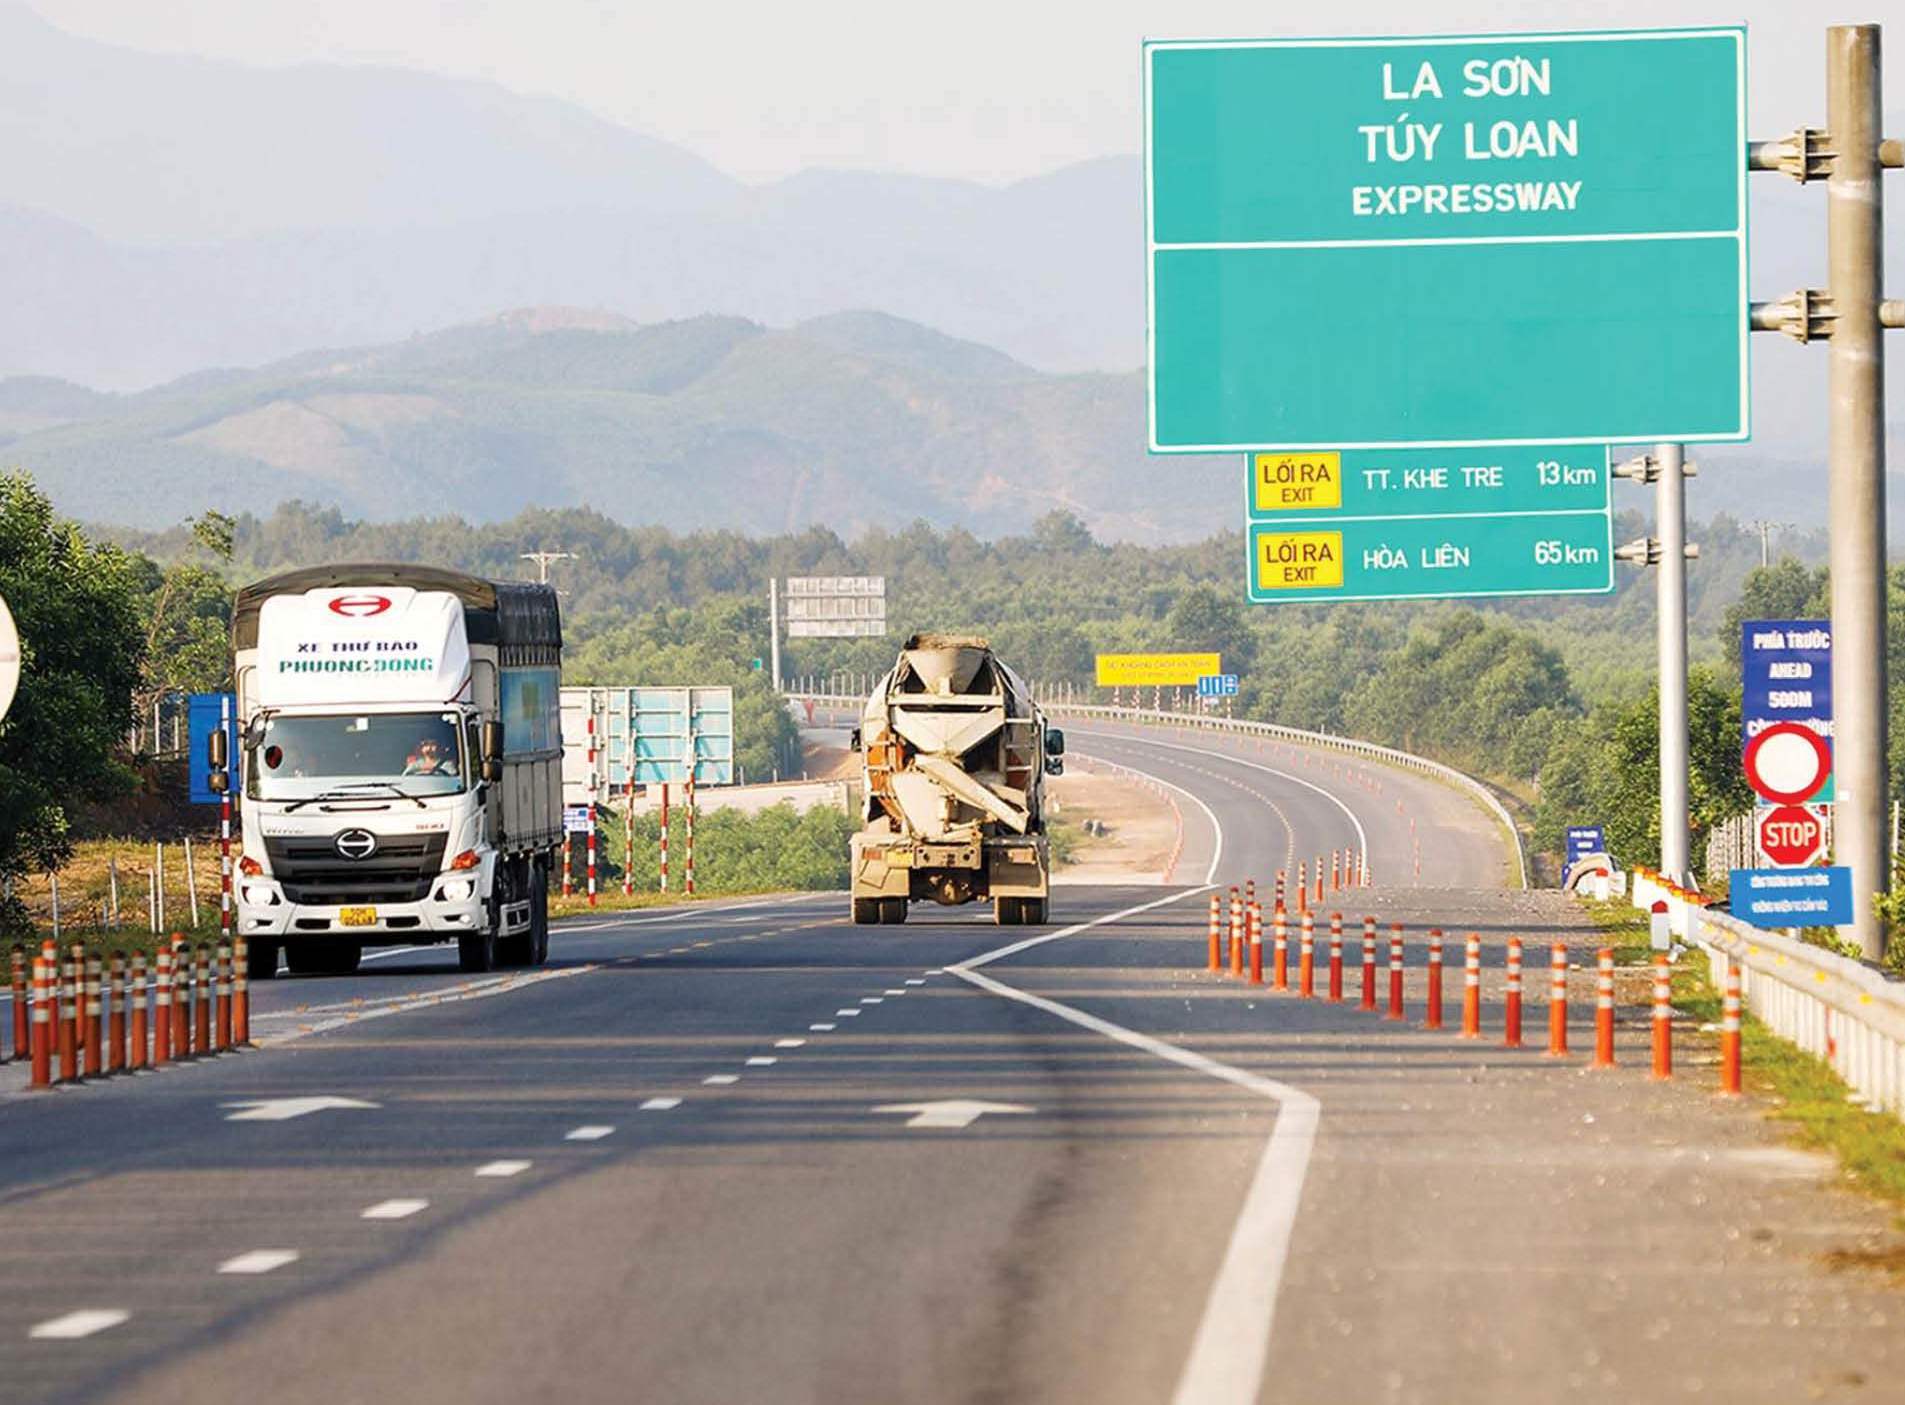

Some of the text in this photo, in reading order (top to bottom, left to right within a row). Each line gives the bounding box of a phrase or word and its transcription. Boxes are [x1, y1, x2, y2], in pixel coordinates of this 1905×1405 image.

[1383, 55, 1551, 100] LA SƠN
[1358, 112, 1578, 162] TÚY LOAN
[1352, 180, 1582, 215] EXPRESSWAY
[1264, 458, 1331, 484] LỐI RA
[1362, 469, 1397, 490] TT.
[1404, 468, 1448, 489] KHE
[1460, 466, 1503, 488] TRE
[1281, 487, 1314, 503] EXIT
[1266, 538, 1334, 564] LỐI RA
[1363, 543, 1409, 570] HÒA
[1421, 543, 1470, 569] LIÊN
[1283, 566, 1317, 583] EXIT
[1768, 662, 1813, 679] AHEAD
[1765, 821, 1817, 848] STOP
